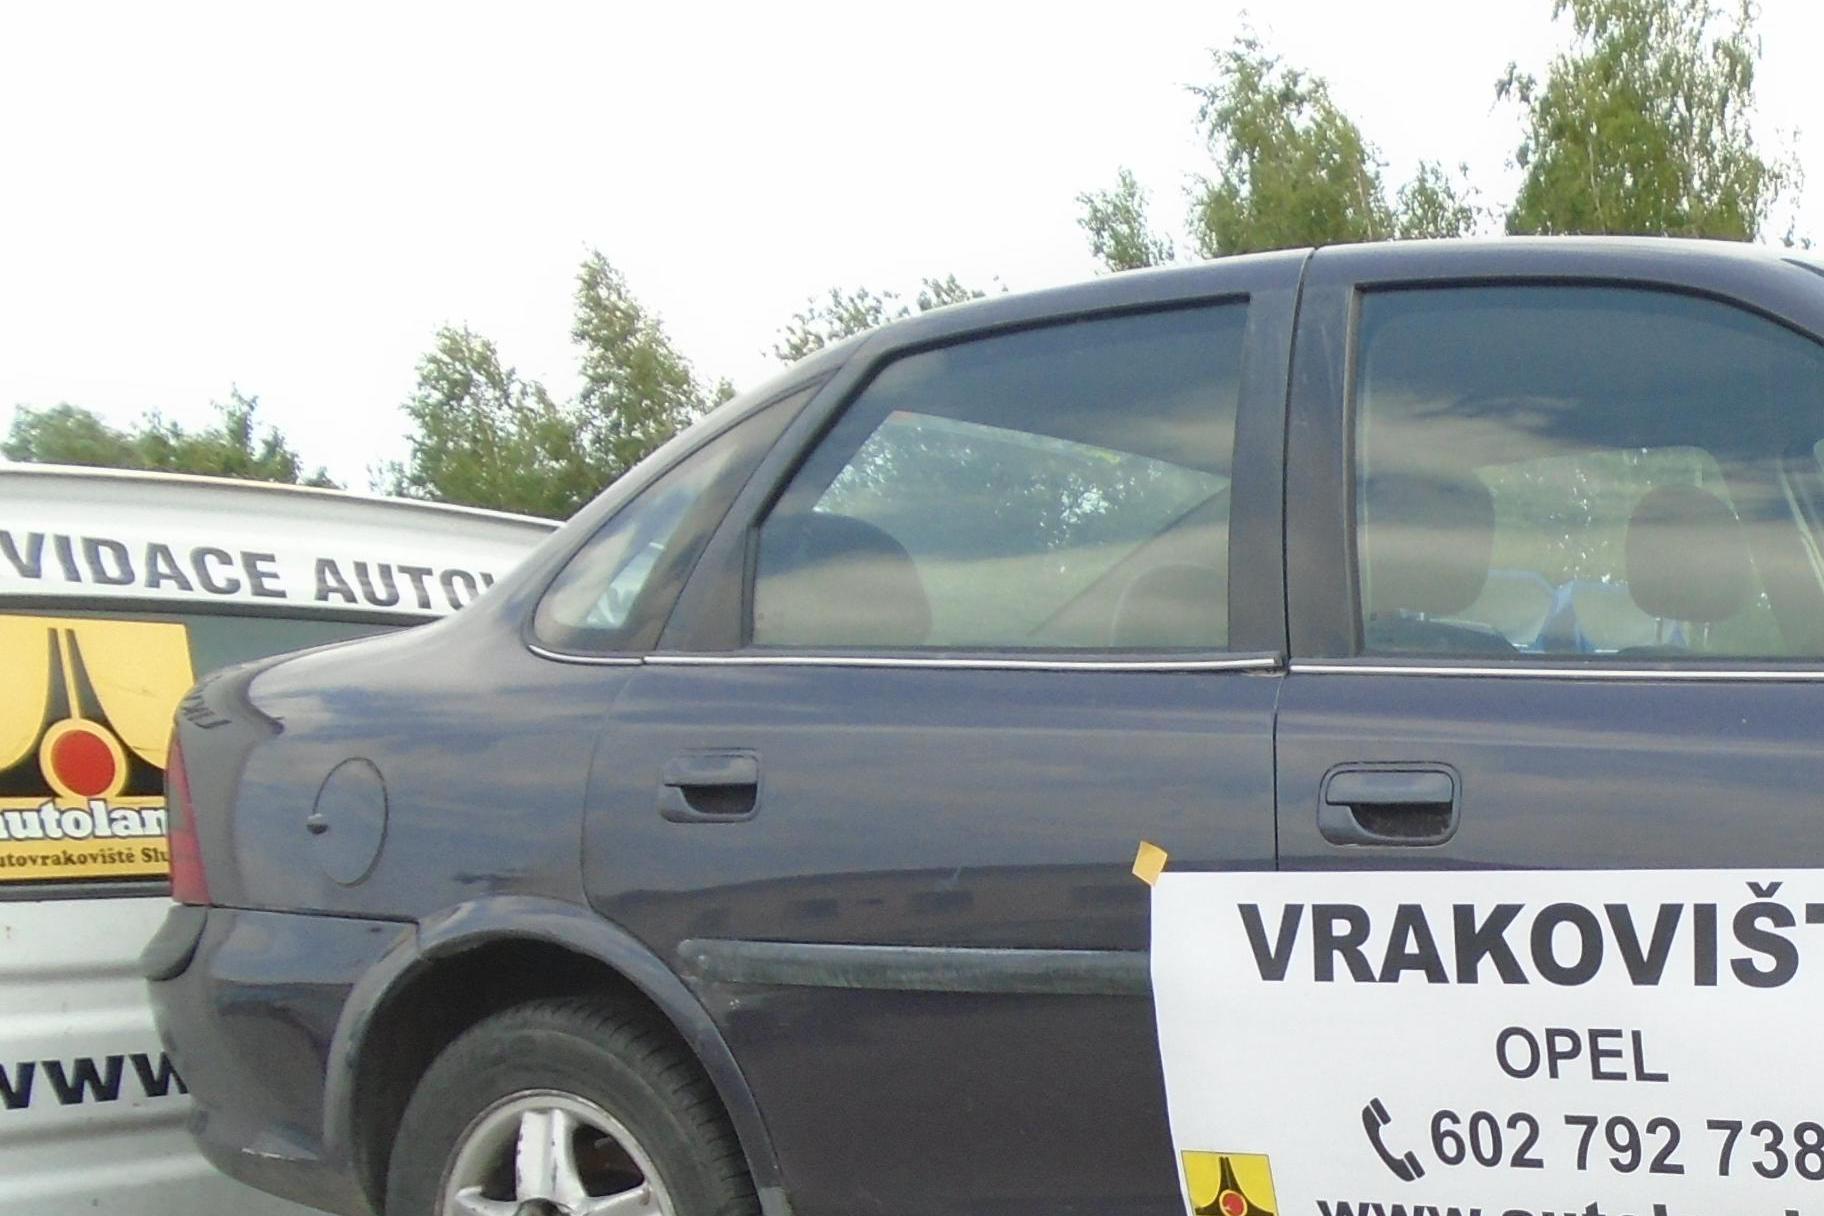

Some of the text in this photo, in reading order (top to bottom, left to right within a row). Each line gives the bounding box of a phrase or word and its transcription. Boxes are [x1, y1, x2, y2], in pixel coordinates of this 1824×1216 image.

[314, 557, 495, 611] AUTO
[1496, 1026, 1669, 1082] OPEL
[1430, 1109, 1545, 1169] 602
[1564, 1114, 1685, 1175] 792
